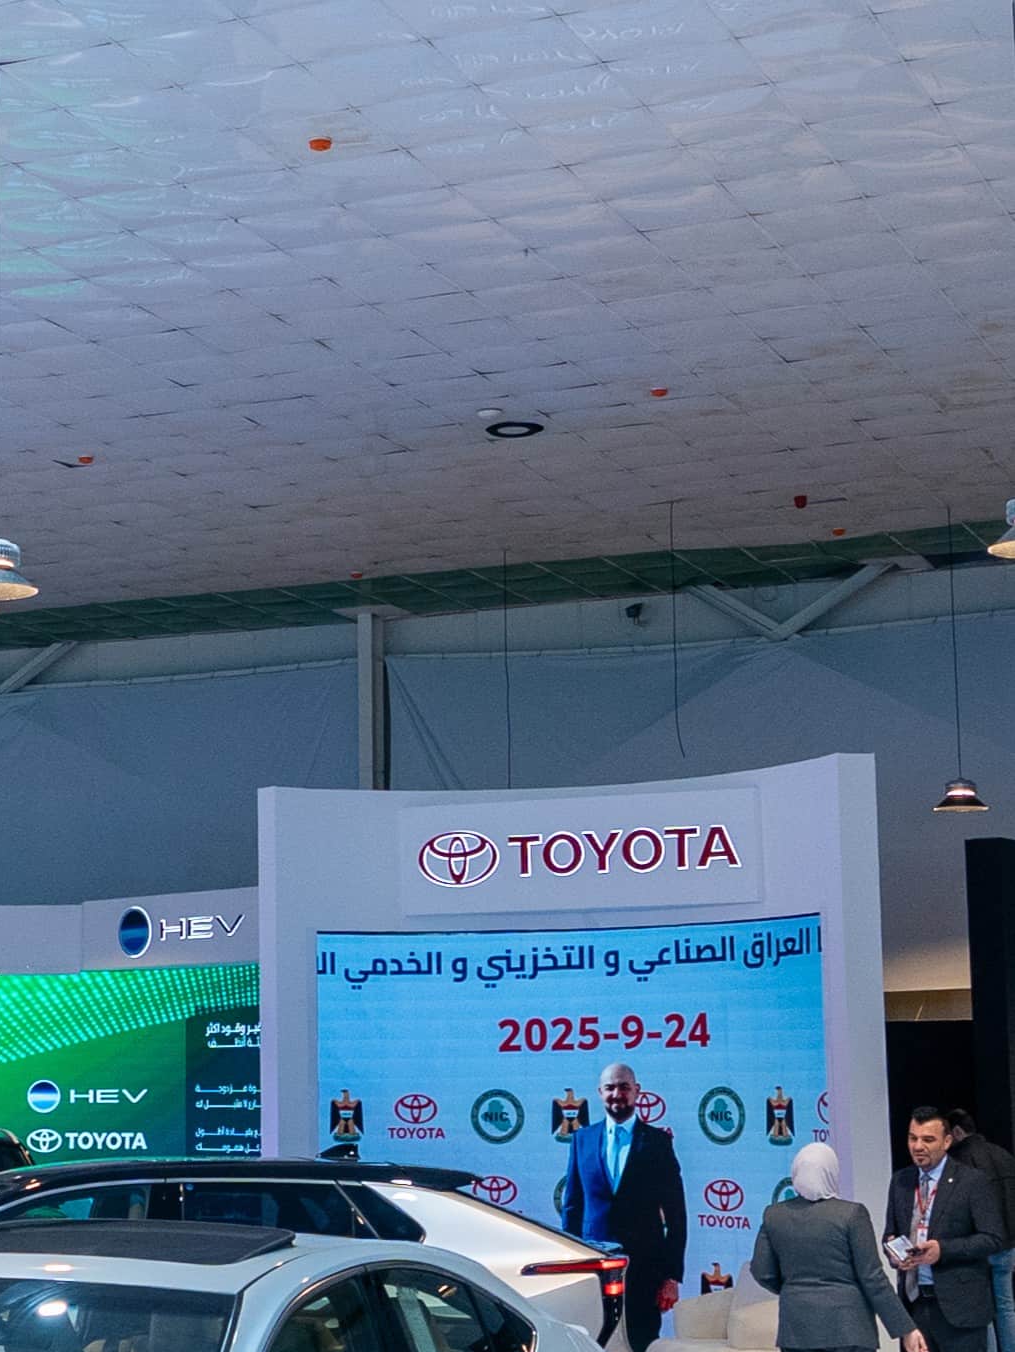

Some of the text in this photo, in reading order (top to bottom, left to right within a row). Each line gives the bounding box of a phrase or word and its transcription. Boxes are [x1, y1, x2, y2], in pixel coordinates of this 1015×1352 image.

[508, 824, 741, 878] TOYOTA
[159, 914, 246, 941] HEV
[628, 935, 735, 982] الصناعي
[743, 927, 811, 969] العراق
[344, 951, 442, 990] الخدمي
[451, 957, 468, 982] و
[476, 944, 594, 988] التخزيني
[604, 950, 620, 976] و
[498, 1012, 711, 1053] 2025-9-24
[69, 1089, 148, 1103] HEV
[484, 1111, 509, 1122] NIC
[710, 1110, 732, 1122] NIC
[65, 1132, 147, 1150] TOYOTA
[388, 1127, 445, 1139] TOYOTA
[697, 1214, 751, 1230] TOYOTA
